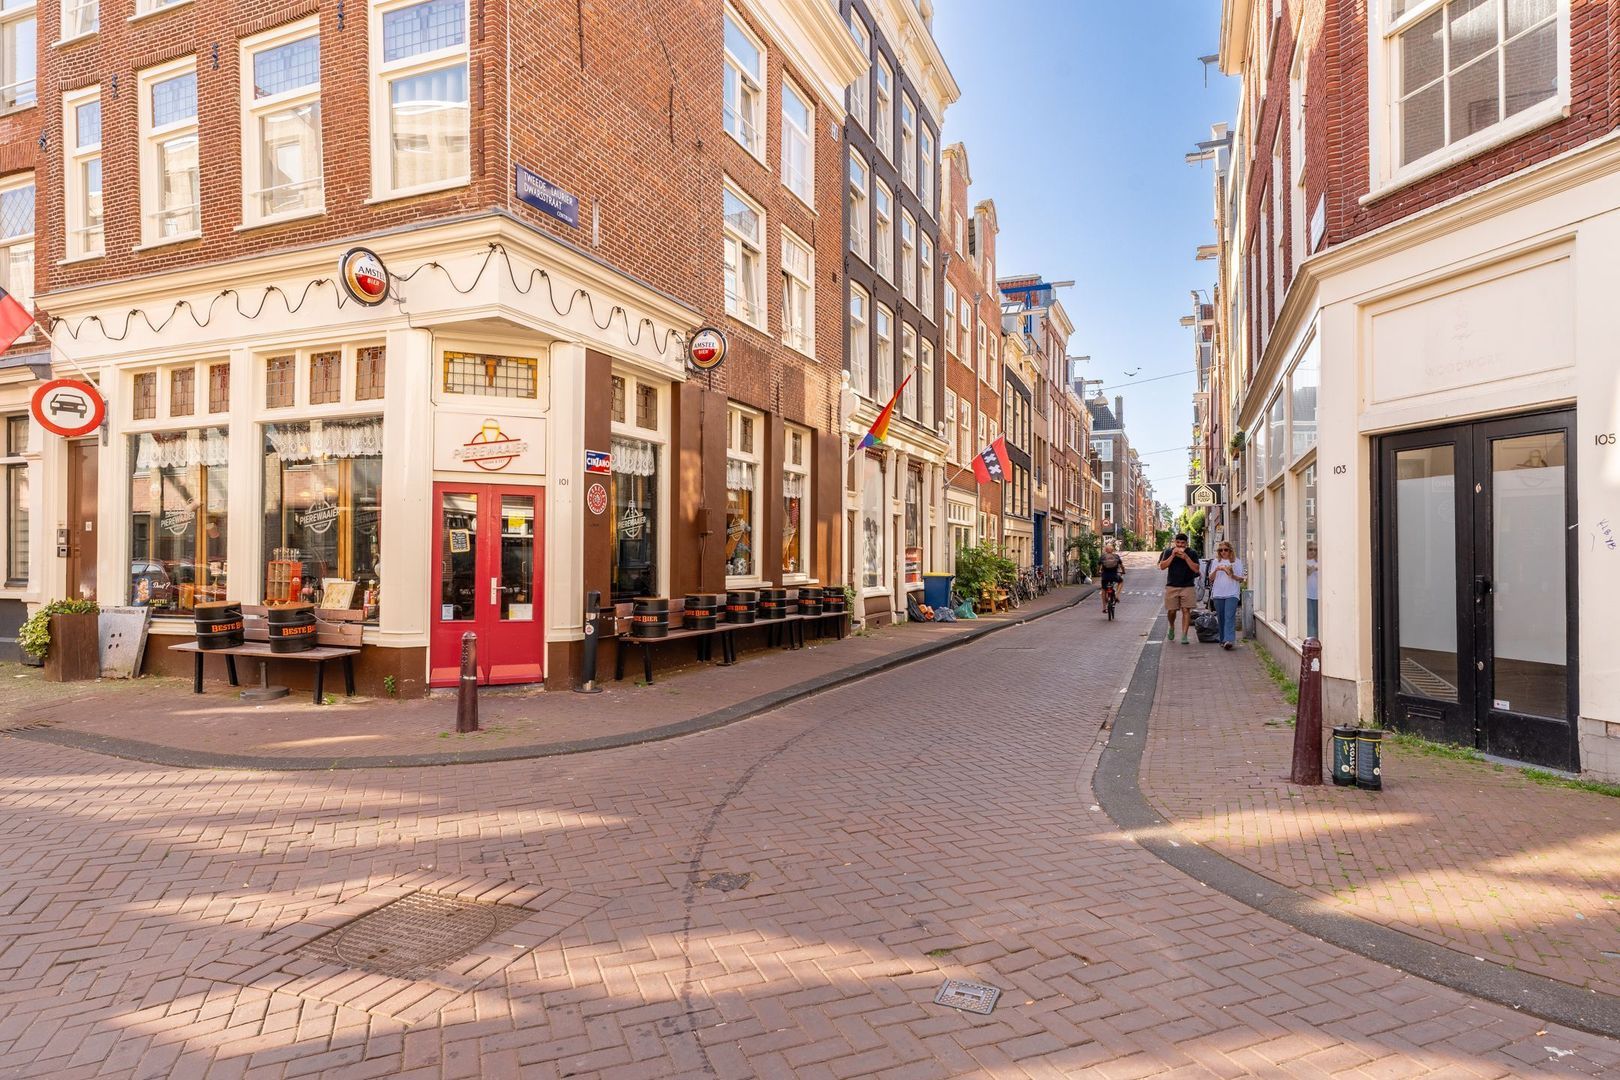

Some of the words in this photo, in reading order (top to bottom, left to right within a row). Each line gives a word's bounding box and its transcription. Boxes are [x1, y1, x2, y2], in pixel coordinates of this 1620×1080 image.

[524, 171, 547, 190] TWEEDE
[551, 187, 574, 206] LAURIER
[523, 182, 563, 211] DWARSSTRAAT
[367, 277, 380, 286] BIER
[1594, 433, 1617, 446] 105
[452, 442, 529, 460] PIEREWAAIER
[586, 457, 611, 468] CINZANO
[1333, 464, 1347, 475] 103
[558, 478, 569, 486] 101
[299, 507, 341, 525] PIEREWAAIER
[642, 615, 658, 623] BIER
[211, 622, 236, 633] BESTE
[282, 626, 307, 637] BESTE
